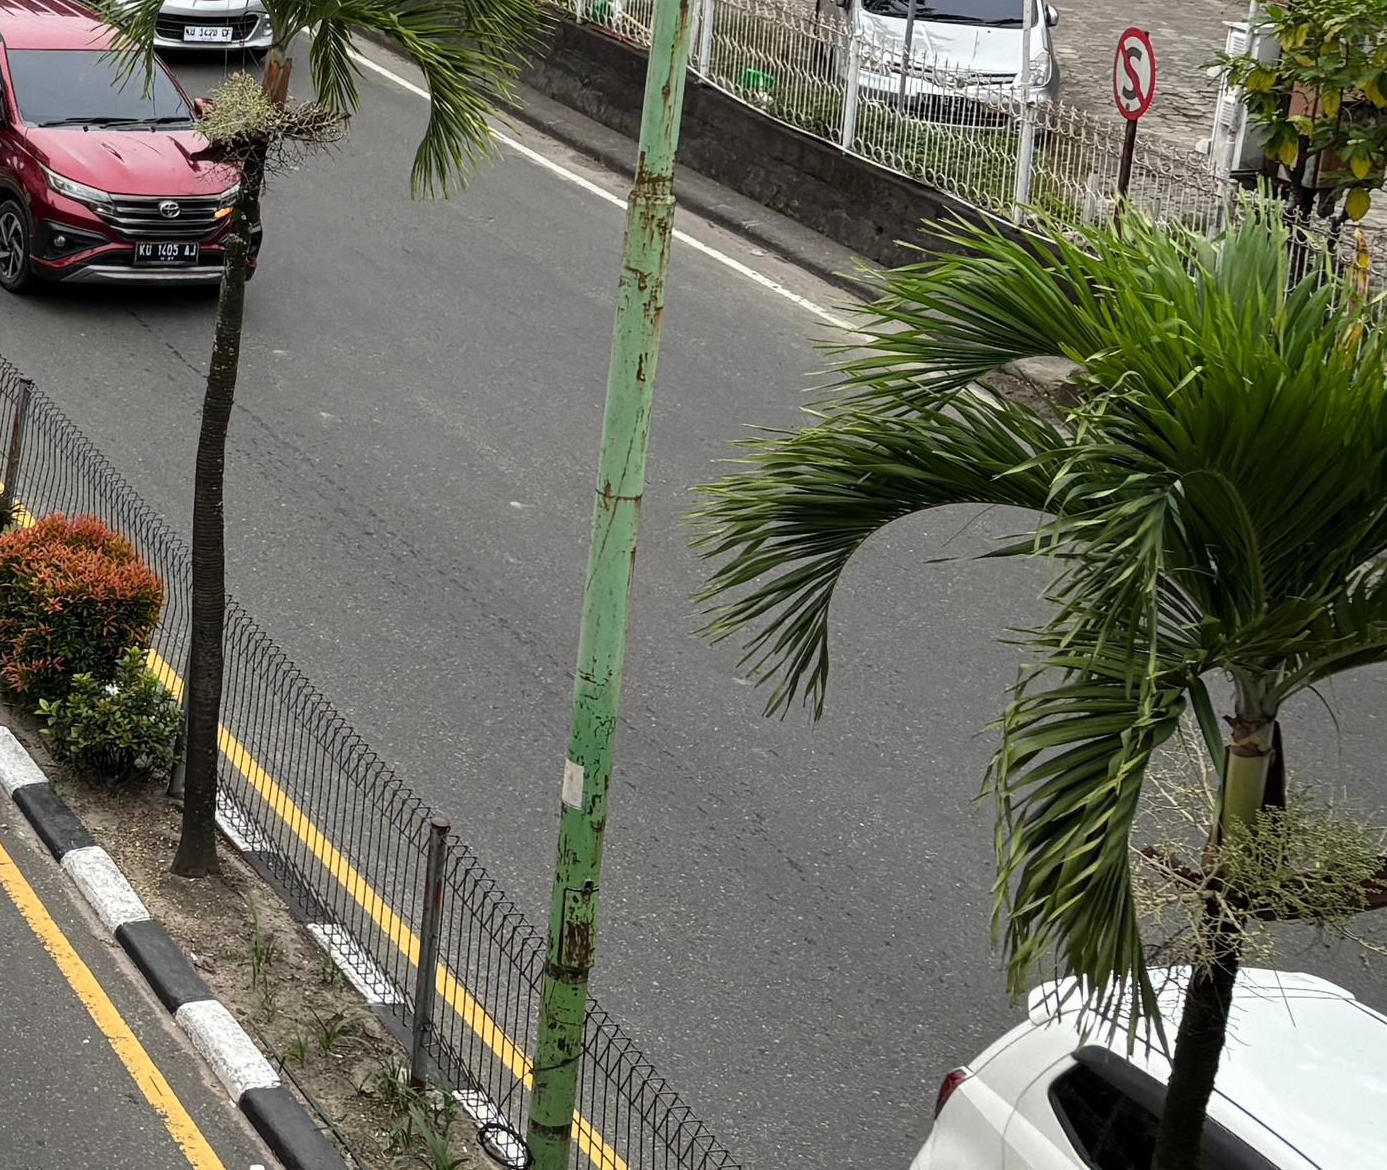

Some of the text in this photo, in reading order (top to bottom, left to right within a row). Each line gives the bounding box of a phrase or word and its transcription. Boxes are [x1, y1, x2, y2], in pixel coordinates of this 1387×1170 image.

[140, 244, 197, 256] KU 1405 AJ
